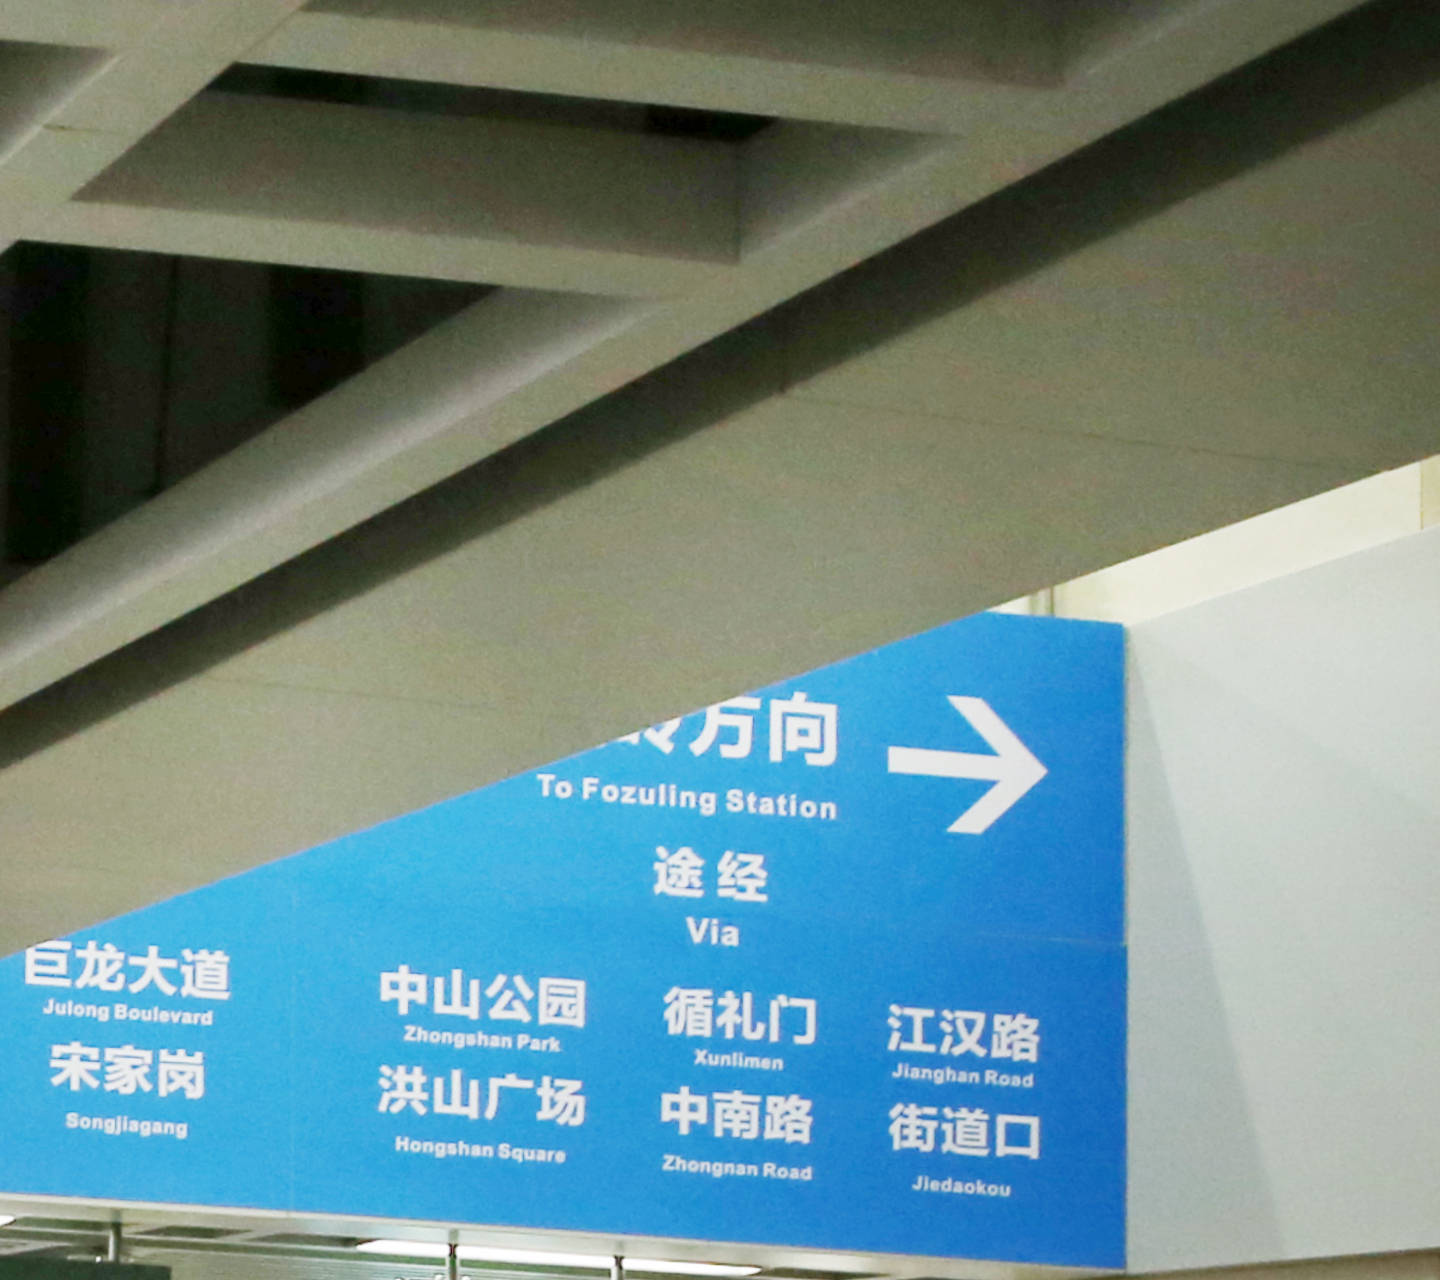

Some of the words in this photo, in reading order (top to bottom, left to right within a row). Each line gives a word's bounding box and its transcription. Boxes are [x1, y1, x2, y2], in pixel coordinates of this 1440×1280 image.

[537, 773, 572, 801] To
[582, 777, 716, 816] Fozuling
[726, 789, 837, 820] Station
[652, 846, 769, 904] 途经
[686, 916, 741, 948] Via
[25, 941, 231, 1001] 巨龙大道
[43, 999, 109, 1026] Julong
[115, 1002, 213, 1027] Boulevard
[380, 964, 587, 1028] 中山公园
[663, 986, 817, 1047] 循礼门
[403, 1025, 510, 1052] Zhongshan
[517, 1032, 561, 1052] Park
[887, 1004, 1042, 1064] 江汉路
[50, 1042, 205, 1101] 宋家岗
[694, 1049, 784, 1071] Xunlimen
[892, 1062, 979, 1089] Jianghan
[985, 1069, 1034, 1088] Road
[377, 1065, 587, 1128] 洪山广场
[660, 1086, 813, 1146] 中南路
[66, 1112, 188, 1140] Songjiagang
[888, 1104, 1041, 1161] 街道口
[394, 1136, 493, 1163] Hongshan
[499, 1142, 566, 1166] Square
[662, 1155, 756, 1181] Zhongnan
[762, 1159, 813, 1182] Road
[911, 1175, 1012, 1198] Jiedaokou
